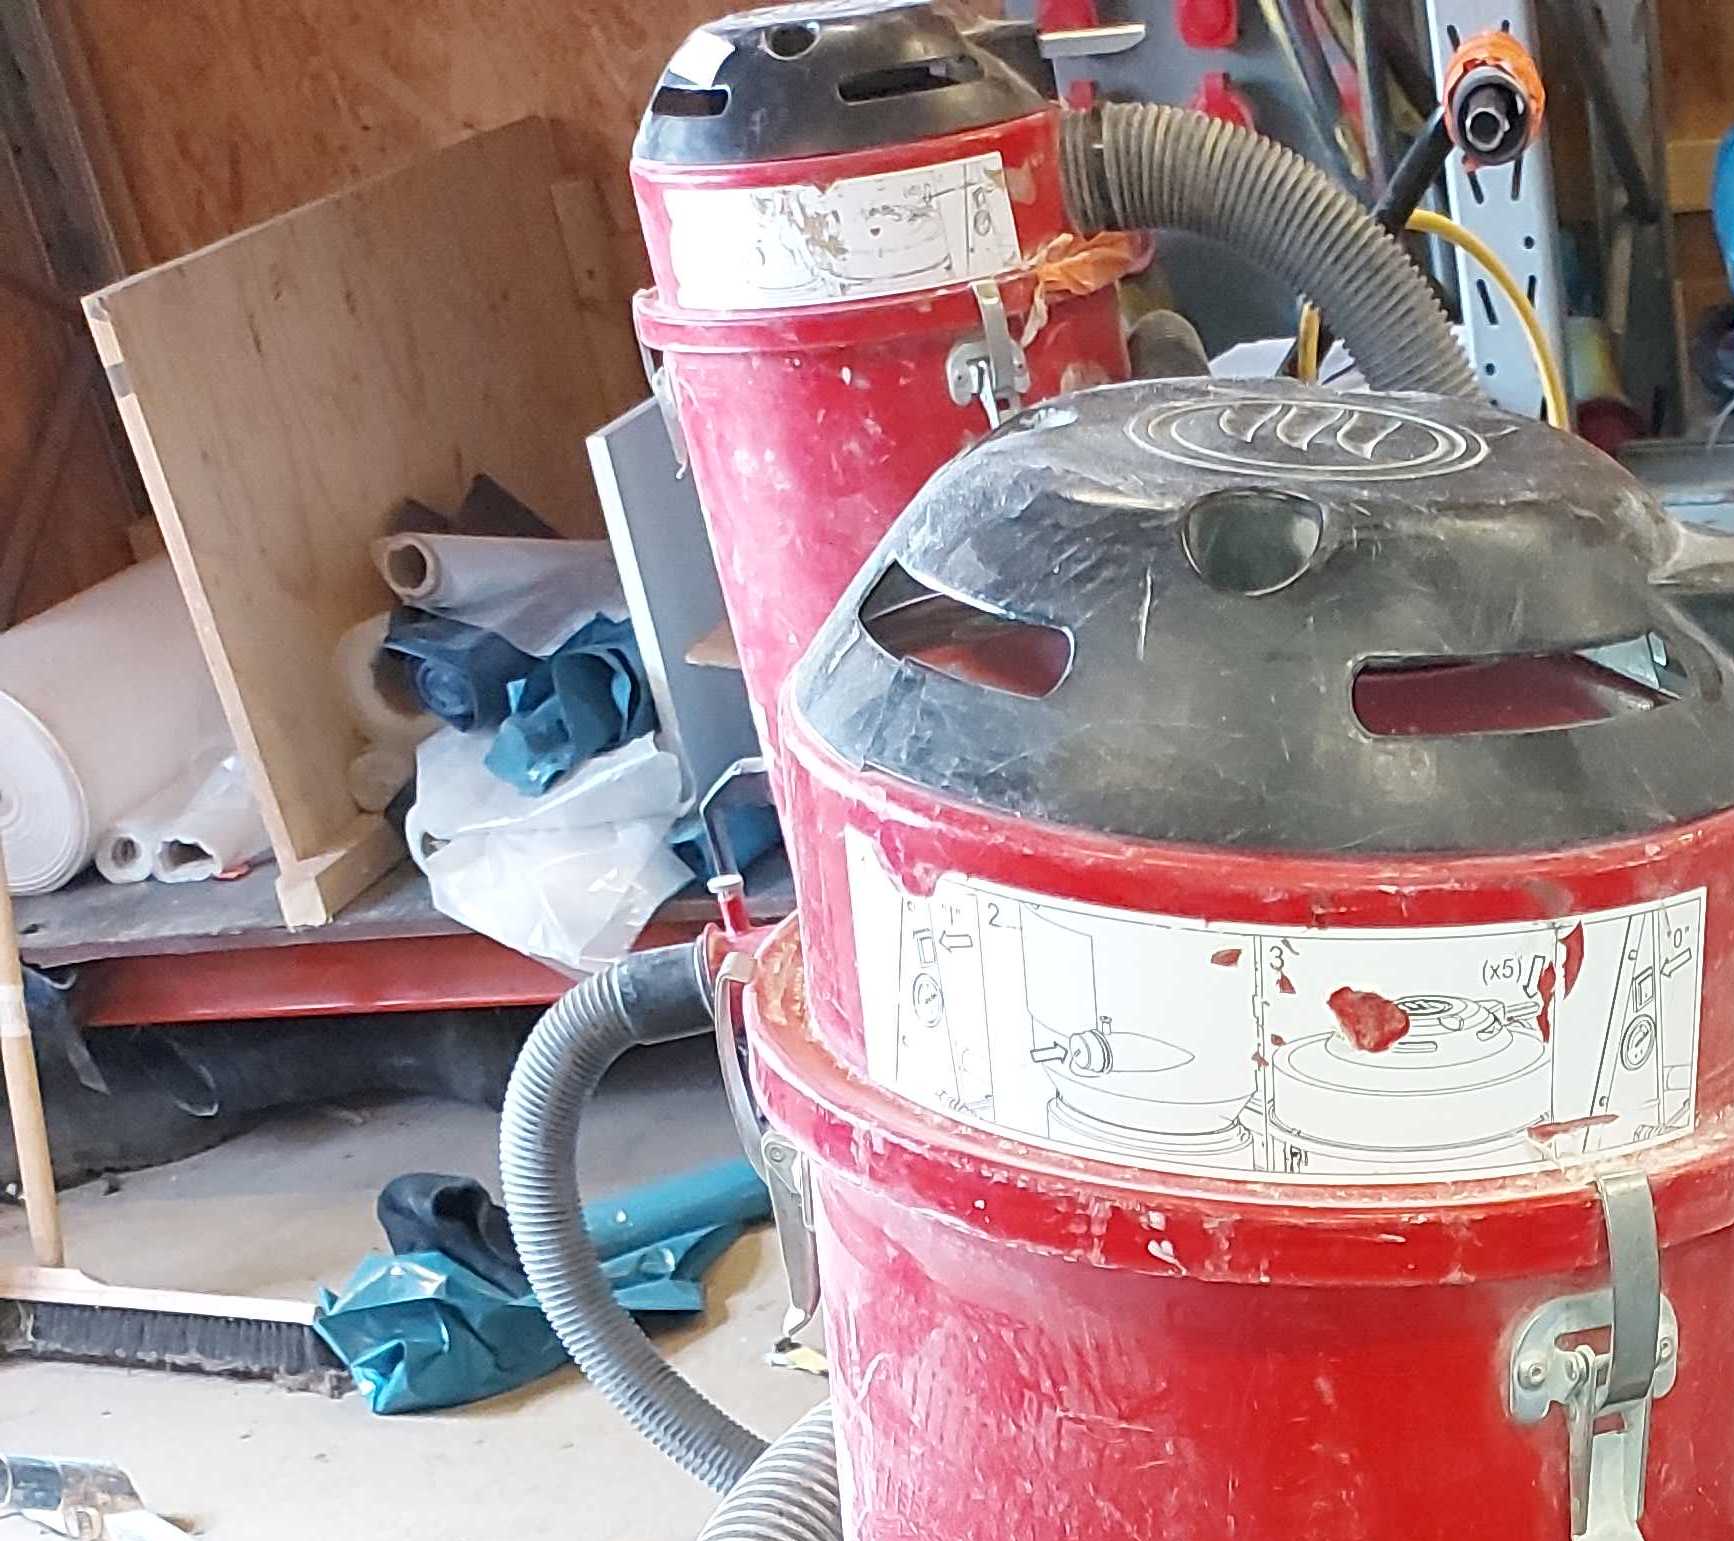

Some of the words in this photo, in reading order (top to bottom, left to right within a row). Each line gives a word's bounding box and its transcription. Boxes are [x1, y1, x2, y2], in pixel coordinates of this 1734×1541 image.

[987, 902, 1003, 928] 2
[1269, 945, 1285, 971] 3
[1482, 957, 1522, 986] (x5)
